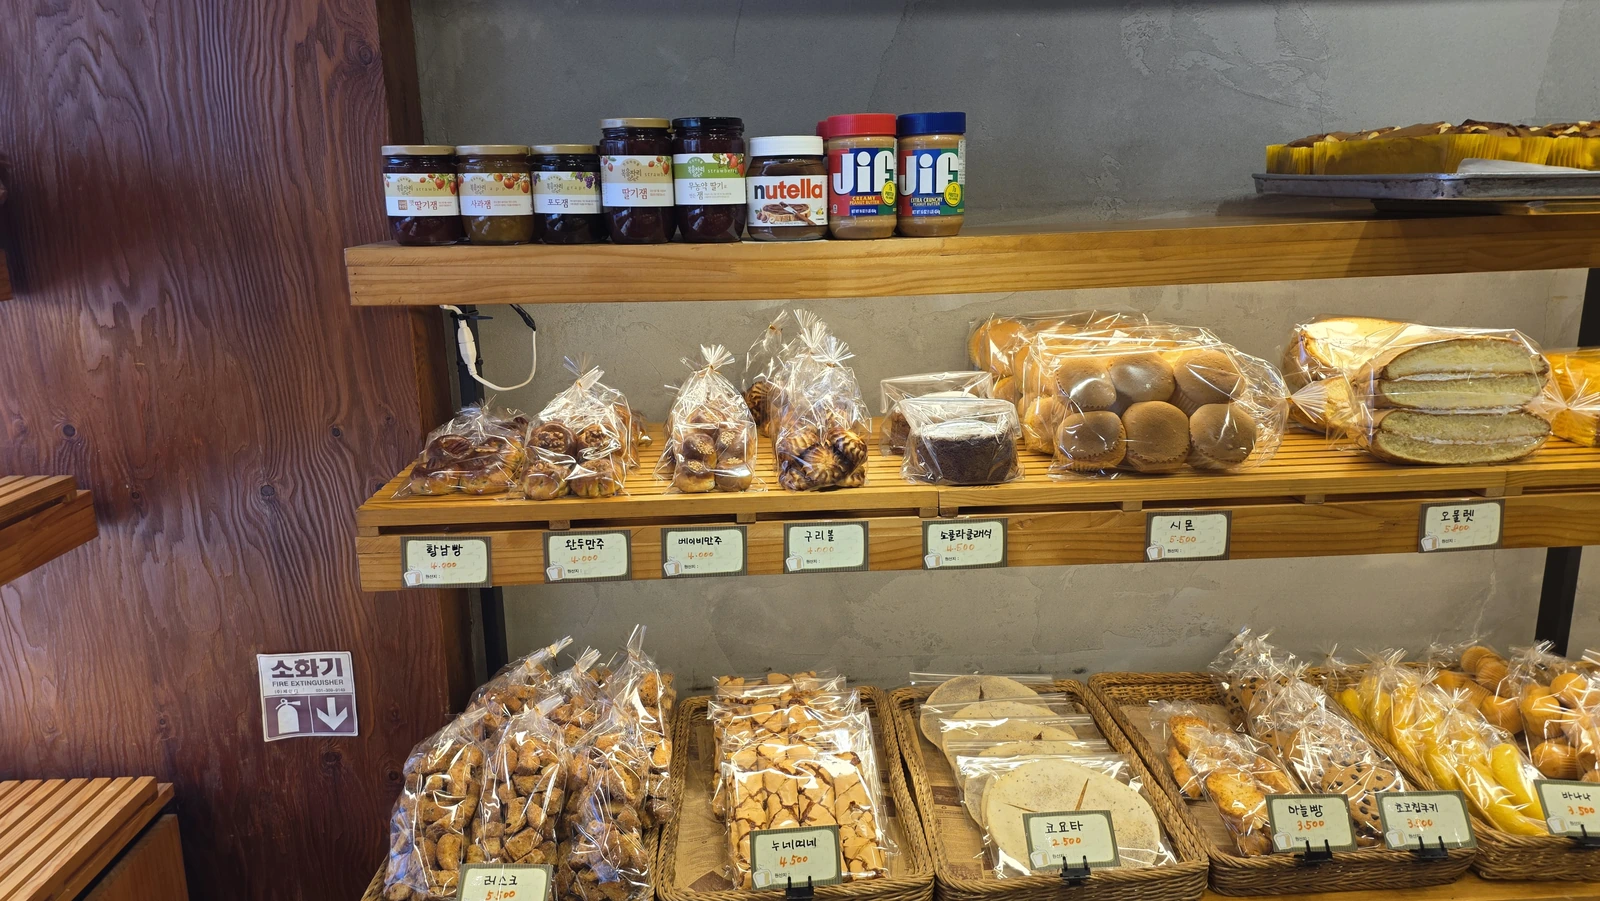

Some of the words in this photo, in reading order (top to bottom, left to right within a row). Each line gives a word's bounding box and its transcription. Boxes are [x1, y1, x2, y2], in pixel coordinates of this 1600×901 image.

[833, 151, 894, 194] Jif
[900, 152, 958, 196] Jif
[688, 182, 708, 191] 무농약
[754, 179, 822, 199] nutella
[622, 188, 647, 199] 딸기잼
[415, 201, 437, 210] 딸기잼
[471, 200, 491, 209] 사과잼
[547, 199, 568, 208] 포도잼
[1170, 519, 1195, 531] 시몬
[678, 536, 722, 545] 베이비만주
[805, 529, 834, 542] 구리볼
[565, 538, 604, 550] 완두만주
[426, 543, 463, 557] 황남빵
[271, 658, 343, 678] 소화기
[291, 679, 344, 687] EXTINGUISHER
[1561, 791, 1591, 801] 바나나
[1395, 802, 1439, 813] 초코칩쿠키
[1567, 806, 1595, 816] 3.500
[1045, 820, 1083, 834] 코요타
[772, 838, 817, 851] 누네띠네
[484, 875, 517, 886] 러스크
